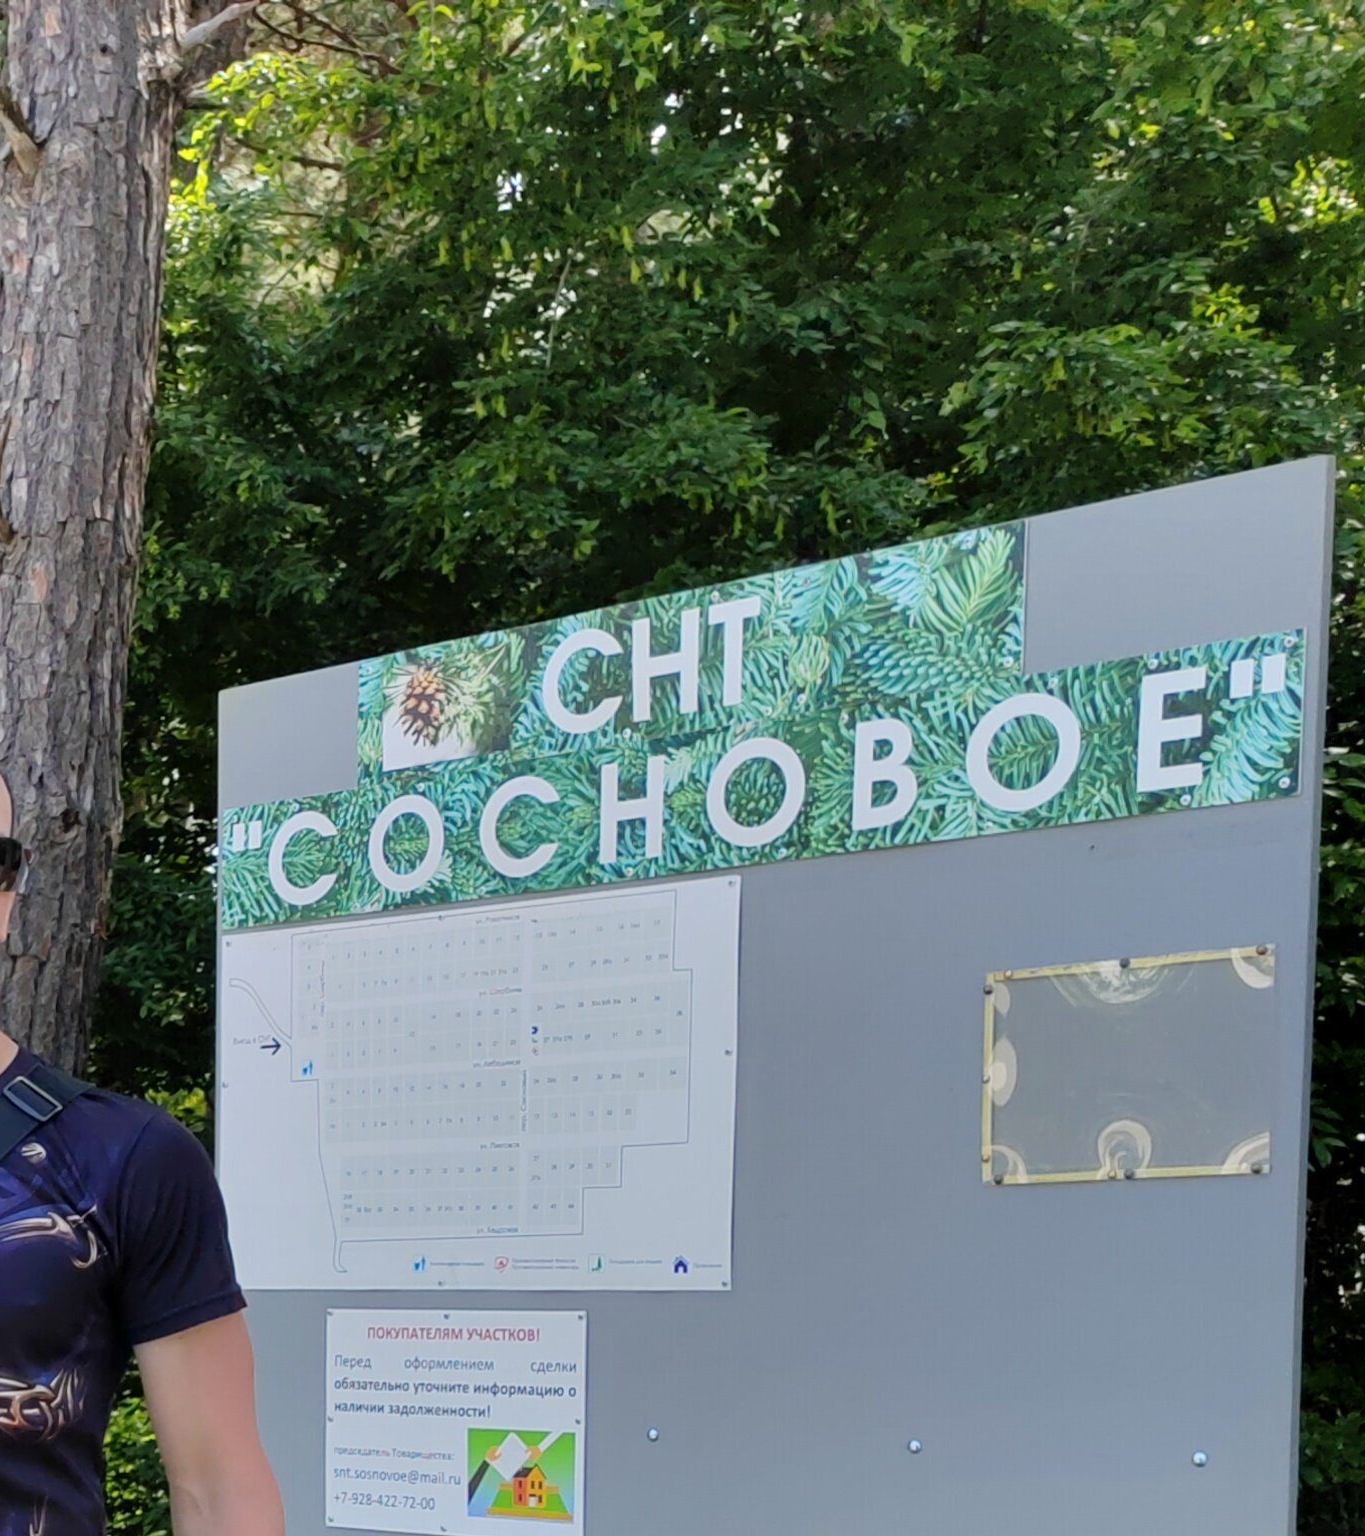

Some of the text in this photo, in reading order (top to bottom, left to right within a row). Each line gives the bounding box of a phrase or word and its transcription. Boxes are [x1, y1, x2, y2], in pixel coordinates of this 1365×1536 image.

[541, 597, 761, 735] СНТ
[367, 1326, 540, 1342] ПОКУПАТЕЛЯМ УЧАСТКОВ!
[334, 1354, 577, 1374] Перед оформлением сделки
[334, 1377, 577, 1397] обязательно уточните информацию о
[334, 1401, 491, 1418] наличии задолженности!
[334, 1492, 436, 1511] +7-928-422-72-00
